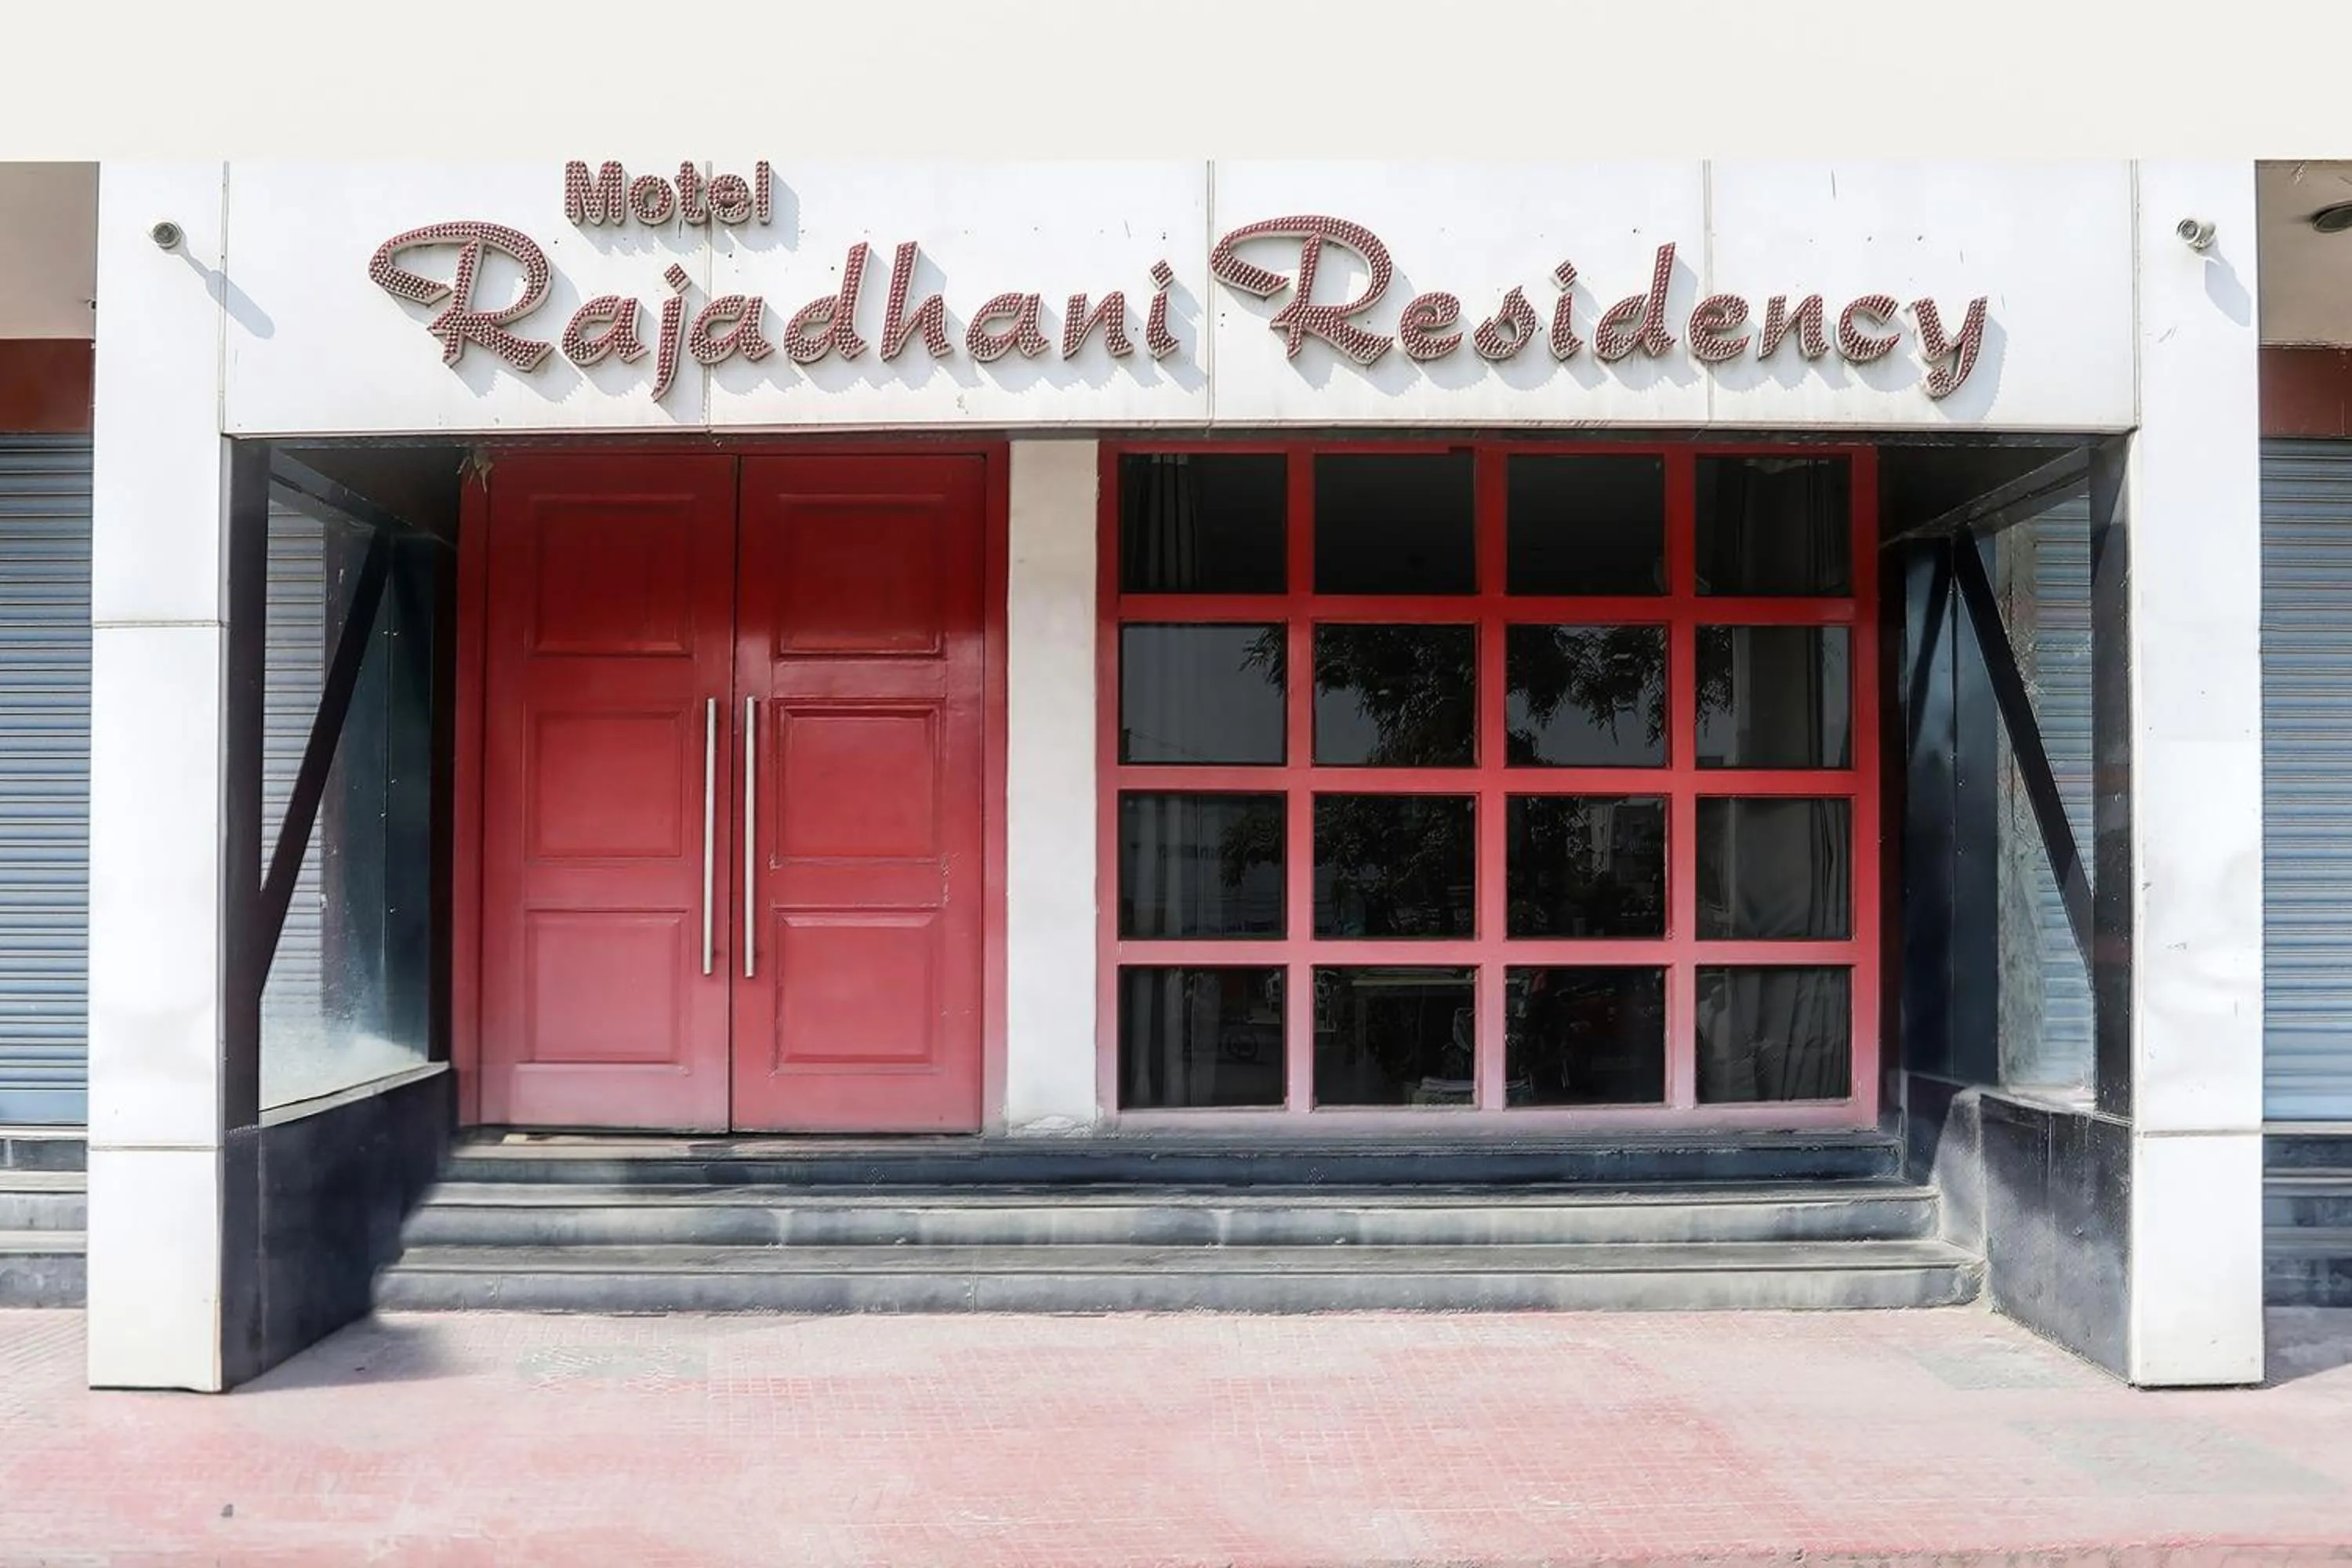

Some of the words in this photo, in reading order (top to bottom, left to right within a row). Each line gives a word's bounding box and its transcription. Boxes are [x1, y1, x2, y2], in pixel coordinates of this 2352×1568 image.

[564, 160, 773, 226] Motel
[368, 221, 1179, 402] Rajadhani
[1210, 215, 1988, 399] Residency
